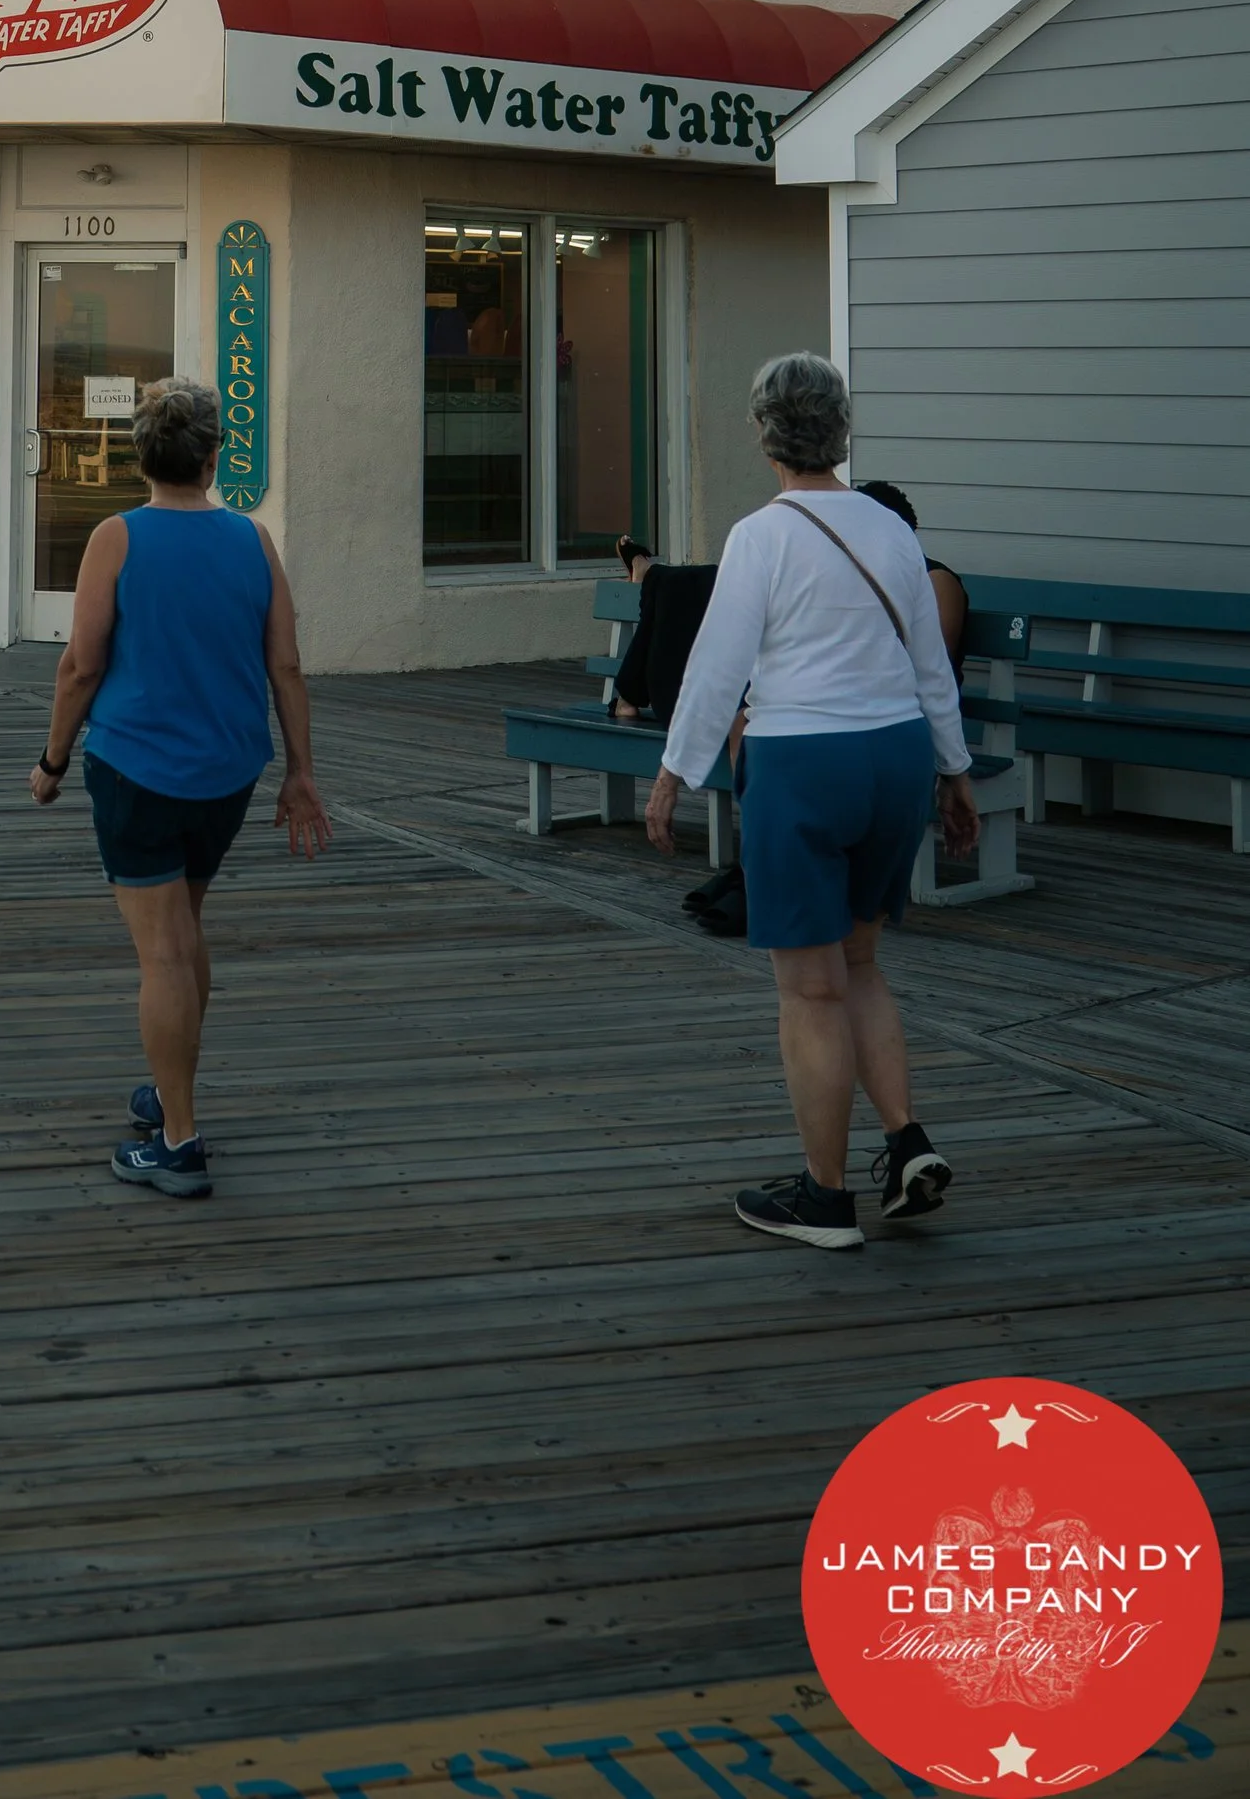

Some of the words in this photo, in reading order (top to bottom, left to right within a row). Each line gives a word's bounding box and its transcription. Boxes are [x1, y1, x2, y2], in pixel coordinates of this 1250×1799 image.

[56, 3, 128, 43] TAFFY
[296, 52, 426, 118] Salt
[441, 66, 625, 137] Water
[640, 83, 787, 163] Taffy
[64, 215, 115, 237] 1100
[227, 257, 255, 474] MACAROONS
[91, 394, 131, 404] CLOSED
